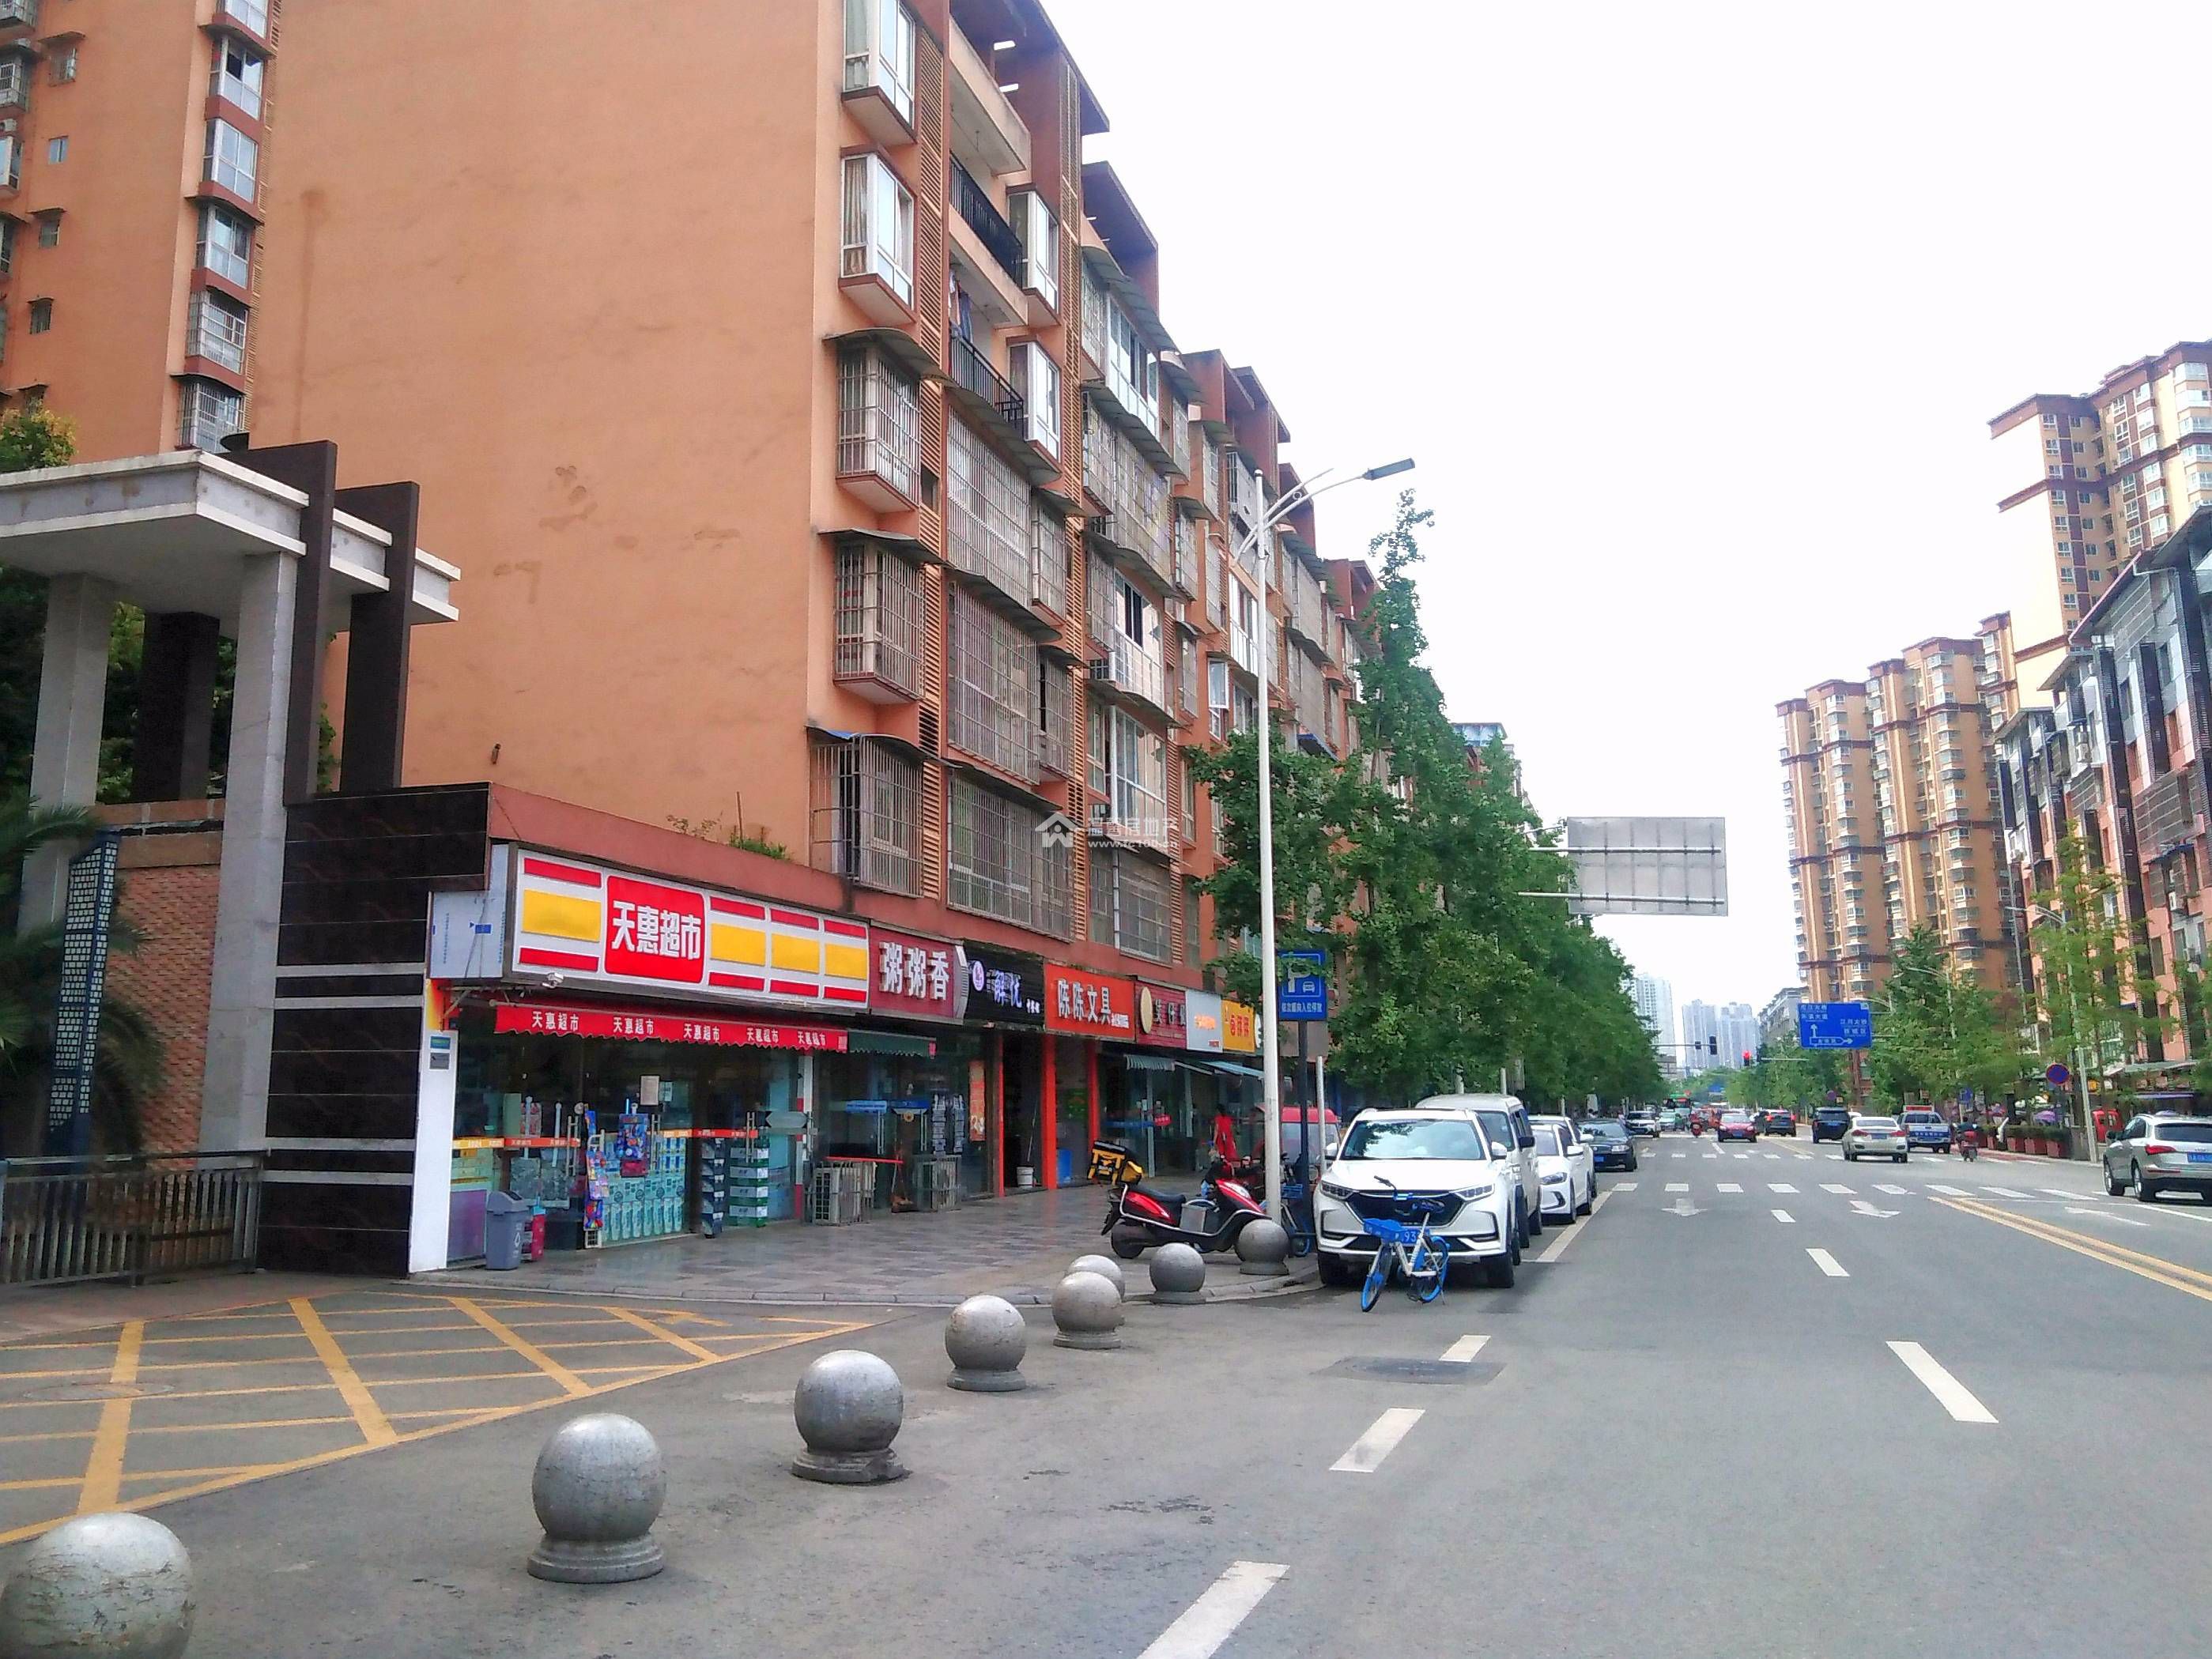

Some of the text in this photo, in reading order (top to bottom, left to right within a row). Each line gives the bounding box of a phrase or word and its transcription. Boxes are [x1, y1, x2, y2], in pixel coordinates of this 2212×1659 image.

[611, 899, 702, 961] 天惠超市
[880, 941, 949, 1001] 粥粥香
[1057, 978, 1112, 1025] 陈陈文具
[532, 1010, 579, 1031] 天惠超市
[613, 1016, 655, 1035] 天惠超市
[683, 1023, 720, 1042] 天惠超市
